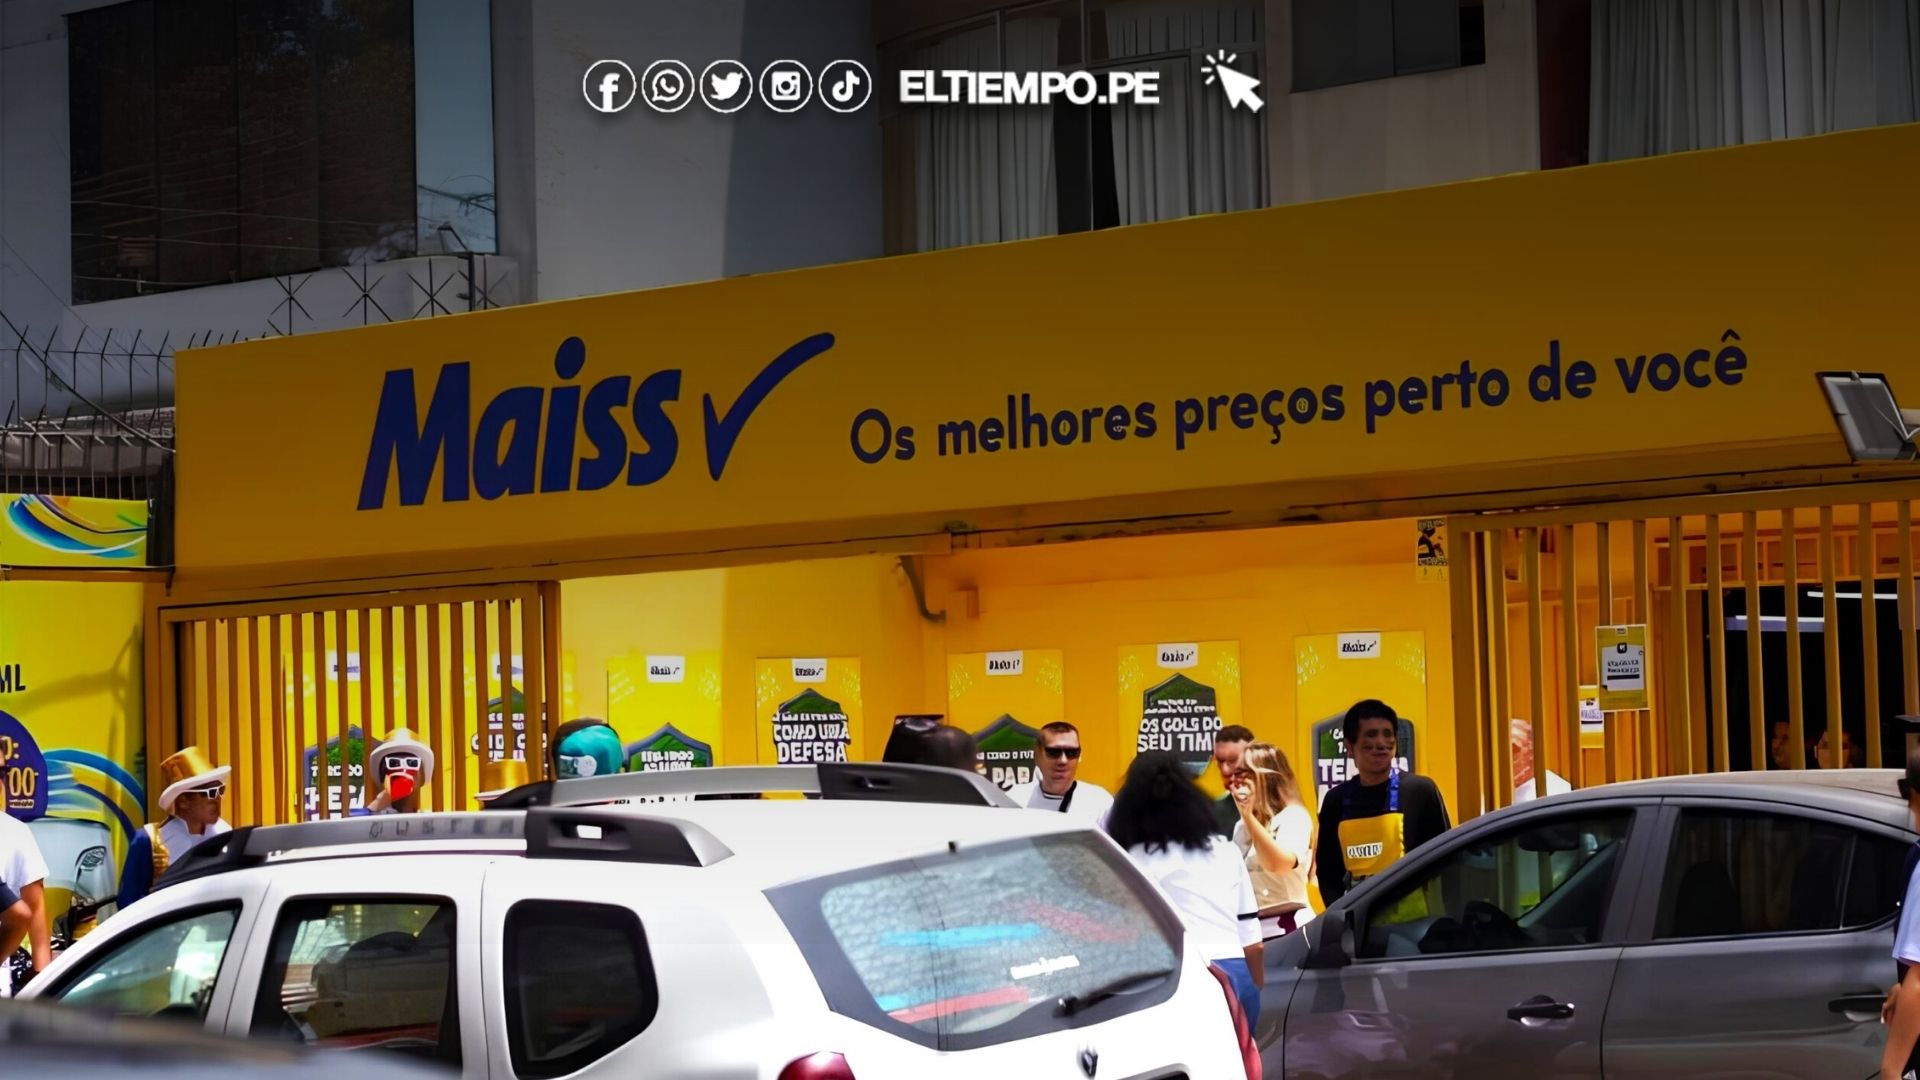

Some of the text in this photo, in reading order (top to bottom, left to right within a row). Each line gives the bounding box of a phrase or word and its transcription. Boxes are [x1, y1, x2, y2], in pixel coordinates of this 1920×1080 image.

[356, 336, 682, 511] Maiss
[850, 328, 1748, 464] Os melhores preços perto de você
[777, 741, 848, 763] DEFESA
[1137, 733, 1172, 752] SEU
